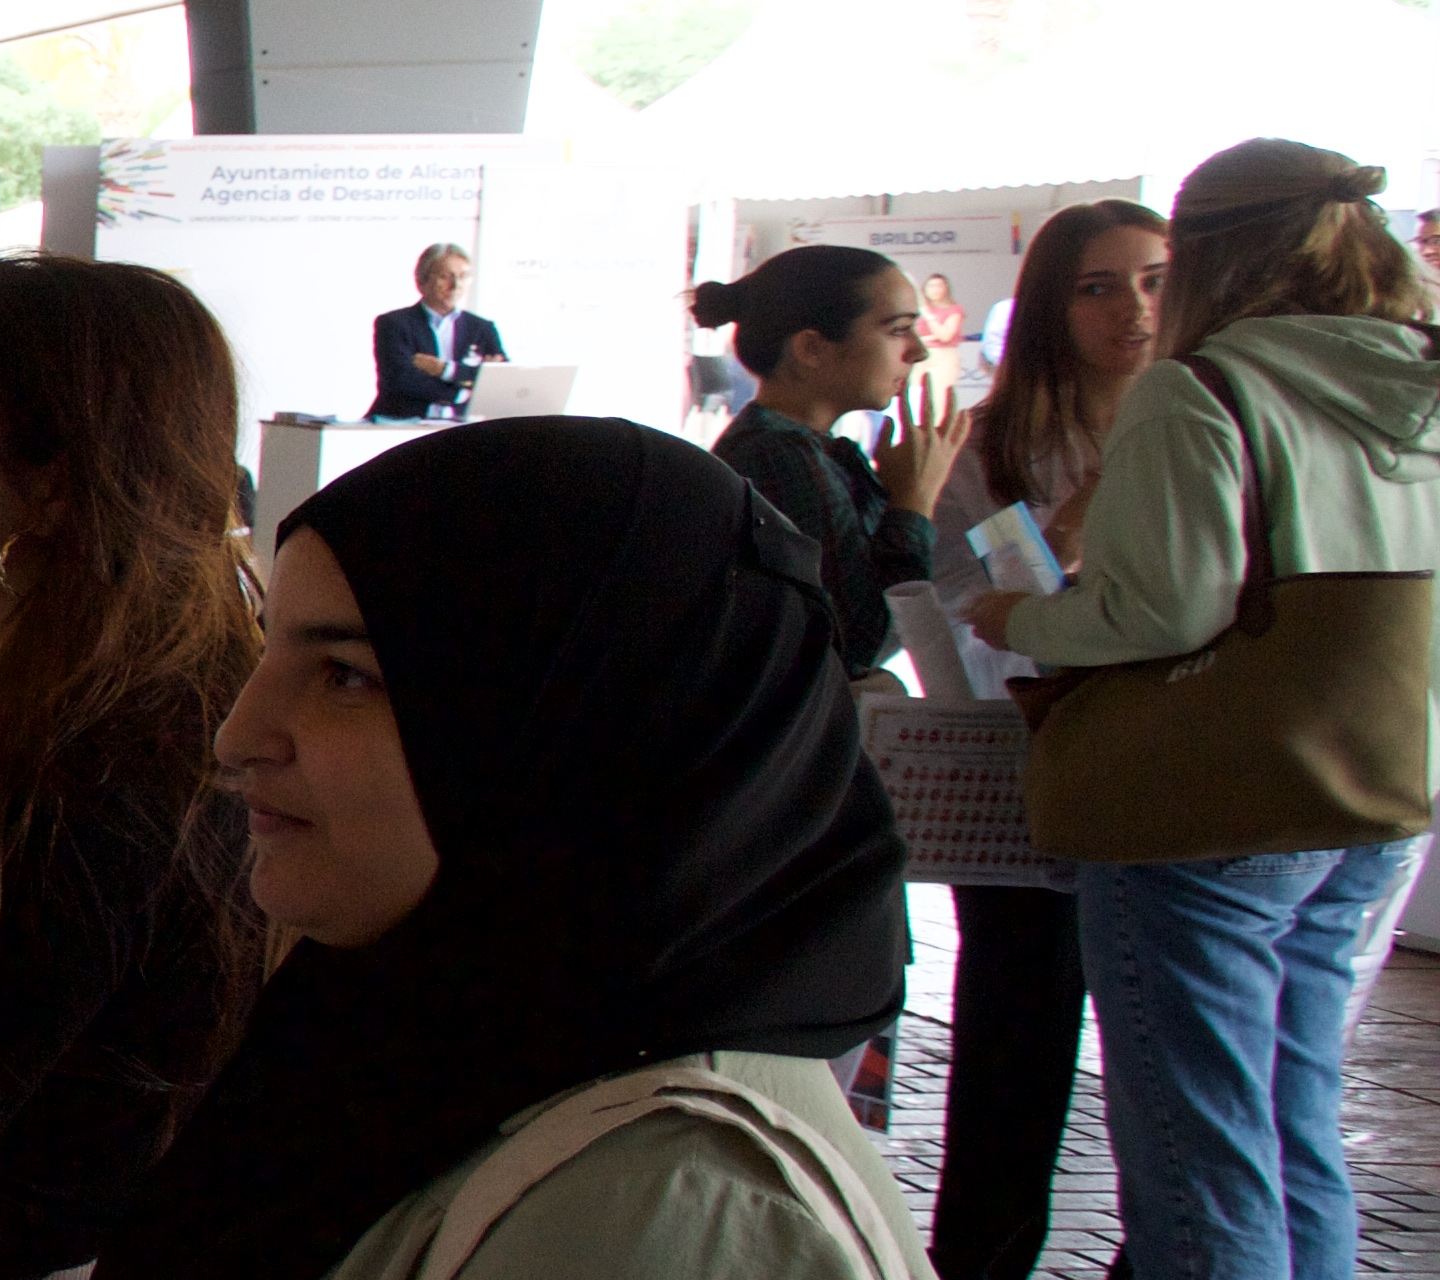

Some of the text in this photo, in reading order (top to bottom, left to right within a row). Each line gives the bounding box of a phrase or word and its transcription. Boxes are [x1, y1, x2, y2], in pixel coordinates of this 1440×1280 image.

[211, 163, 370, 184] Ayuntamiento
[376, 164, 402, 180] de
[201, 185, 291, 205] Agencia
[298, 185, 324, 201] de
[332, 186, 442, 201] Desarrollo
